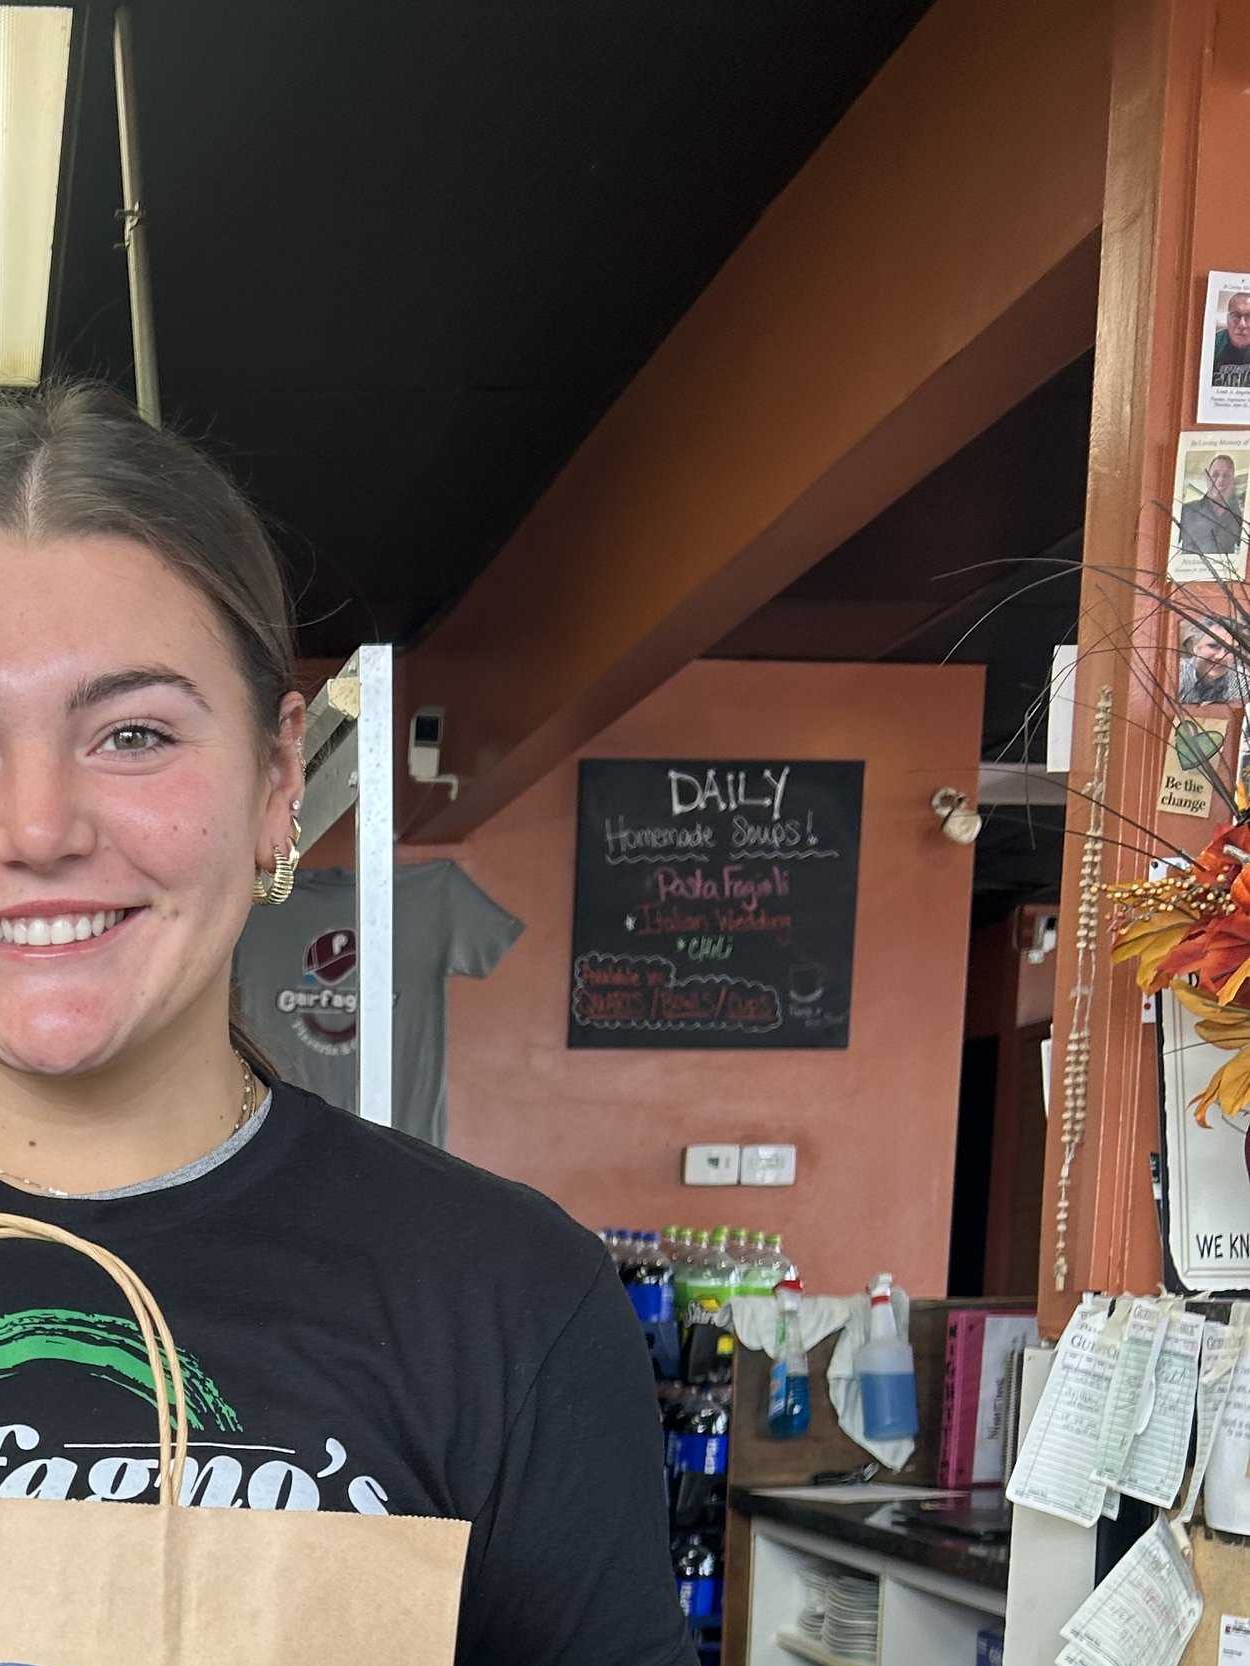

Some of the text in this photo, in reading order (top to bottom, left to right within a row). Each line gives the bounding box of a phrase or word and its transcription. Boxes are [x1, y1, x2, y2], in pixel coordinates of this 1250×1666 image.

[668, 765, 790, 820] DAILY
[1165, 775, 1204, 793] Be the
[1161, 792, 1206, 814] change
[605, 810, 820, 853] Homemade Soups!
[655, 866, 720, 901] Pasta
[1196, 1233, 1223, 1259] WE
